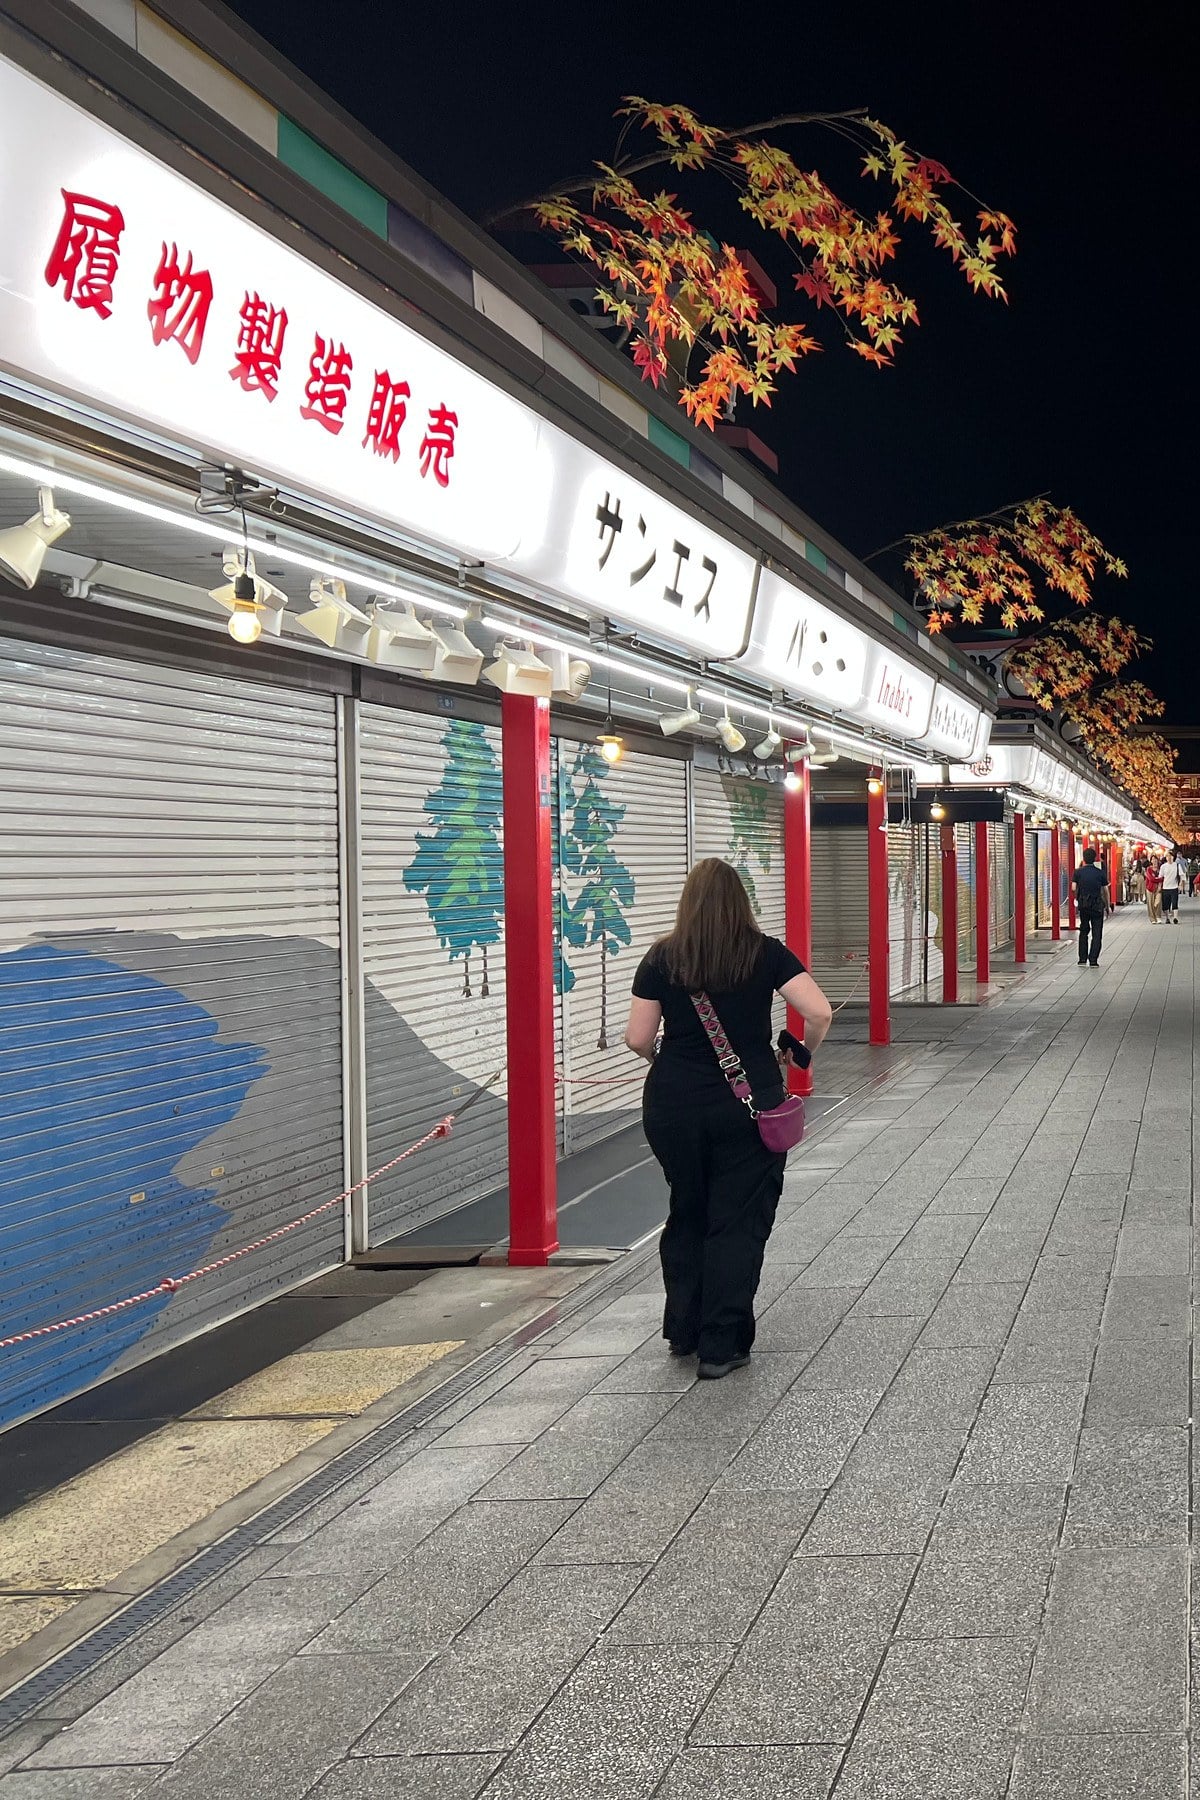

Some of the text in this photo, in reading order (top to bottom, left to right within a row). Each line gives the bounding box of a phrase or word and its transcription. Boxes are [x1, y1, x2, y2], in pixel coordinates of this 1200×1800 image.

[44, 187, 459, 488] 履物製造販売
[595, 490, 718, 623] サンエス
[877, 665, 913, 718] Inaba's
